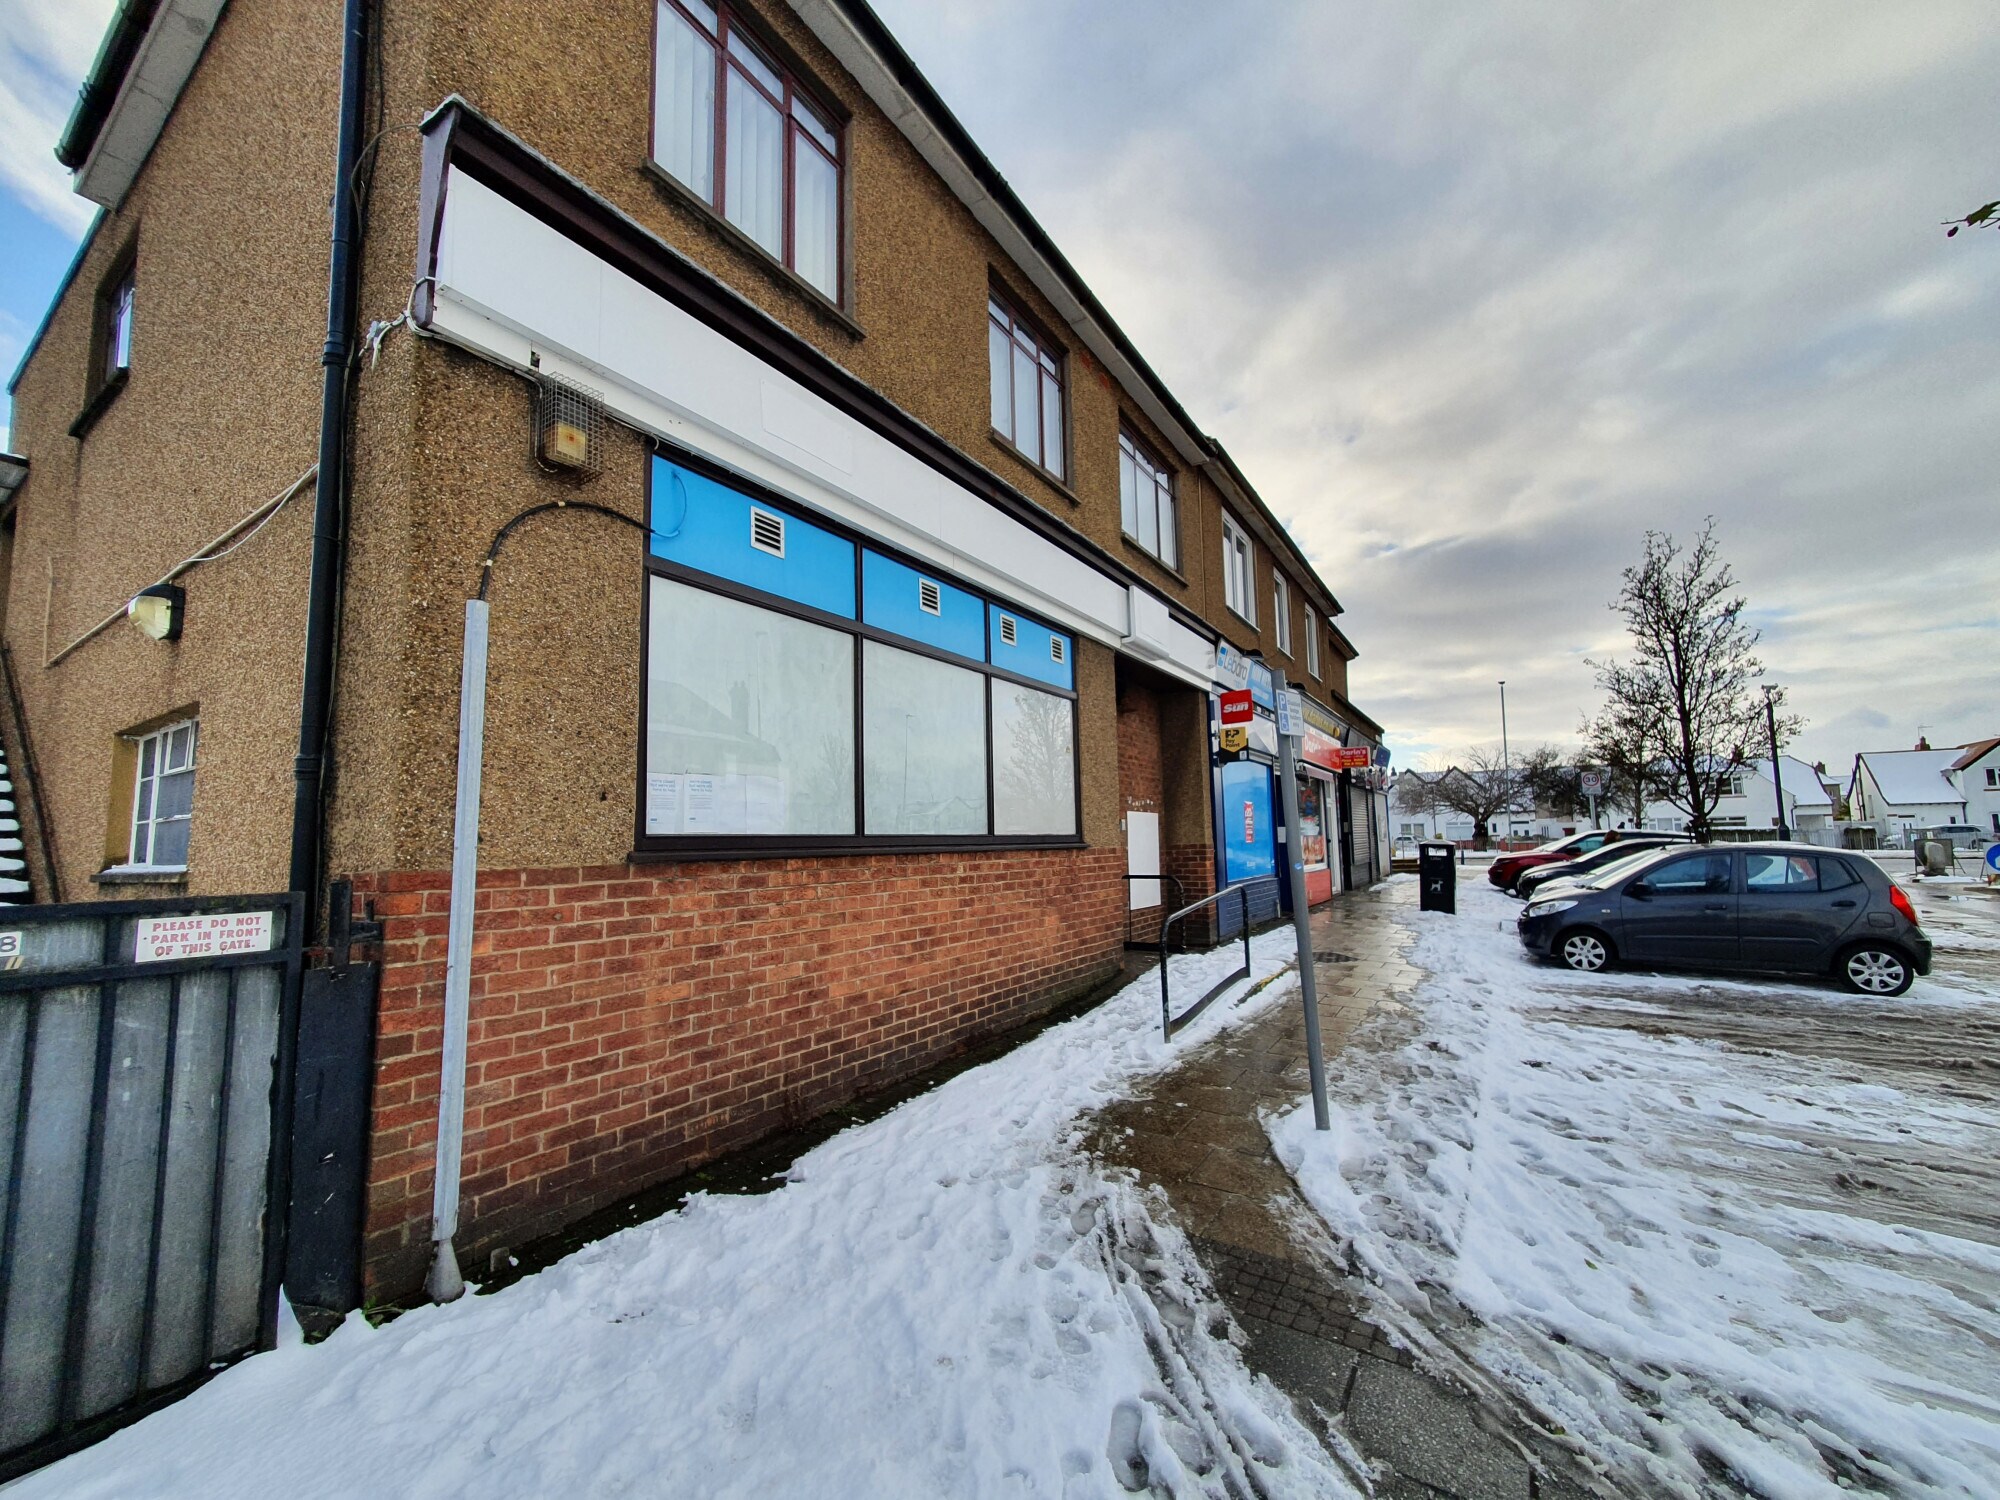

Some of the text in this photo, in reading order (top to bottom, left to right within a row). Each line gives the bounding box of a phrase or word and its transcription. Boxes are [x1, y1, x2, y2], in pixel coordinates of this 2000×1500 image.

[1223, 702, 1249, 713] Sun
[152, 916, 262, 932] PLEASE DO NOT
[150, 927, 261, 944] PARK IN FRONT
[154, 939, 256, 957] OF THIS GATE.
